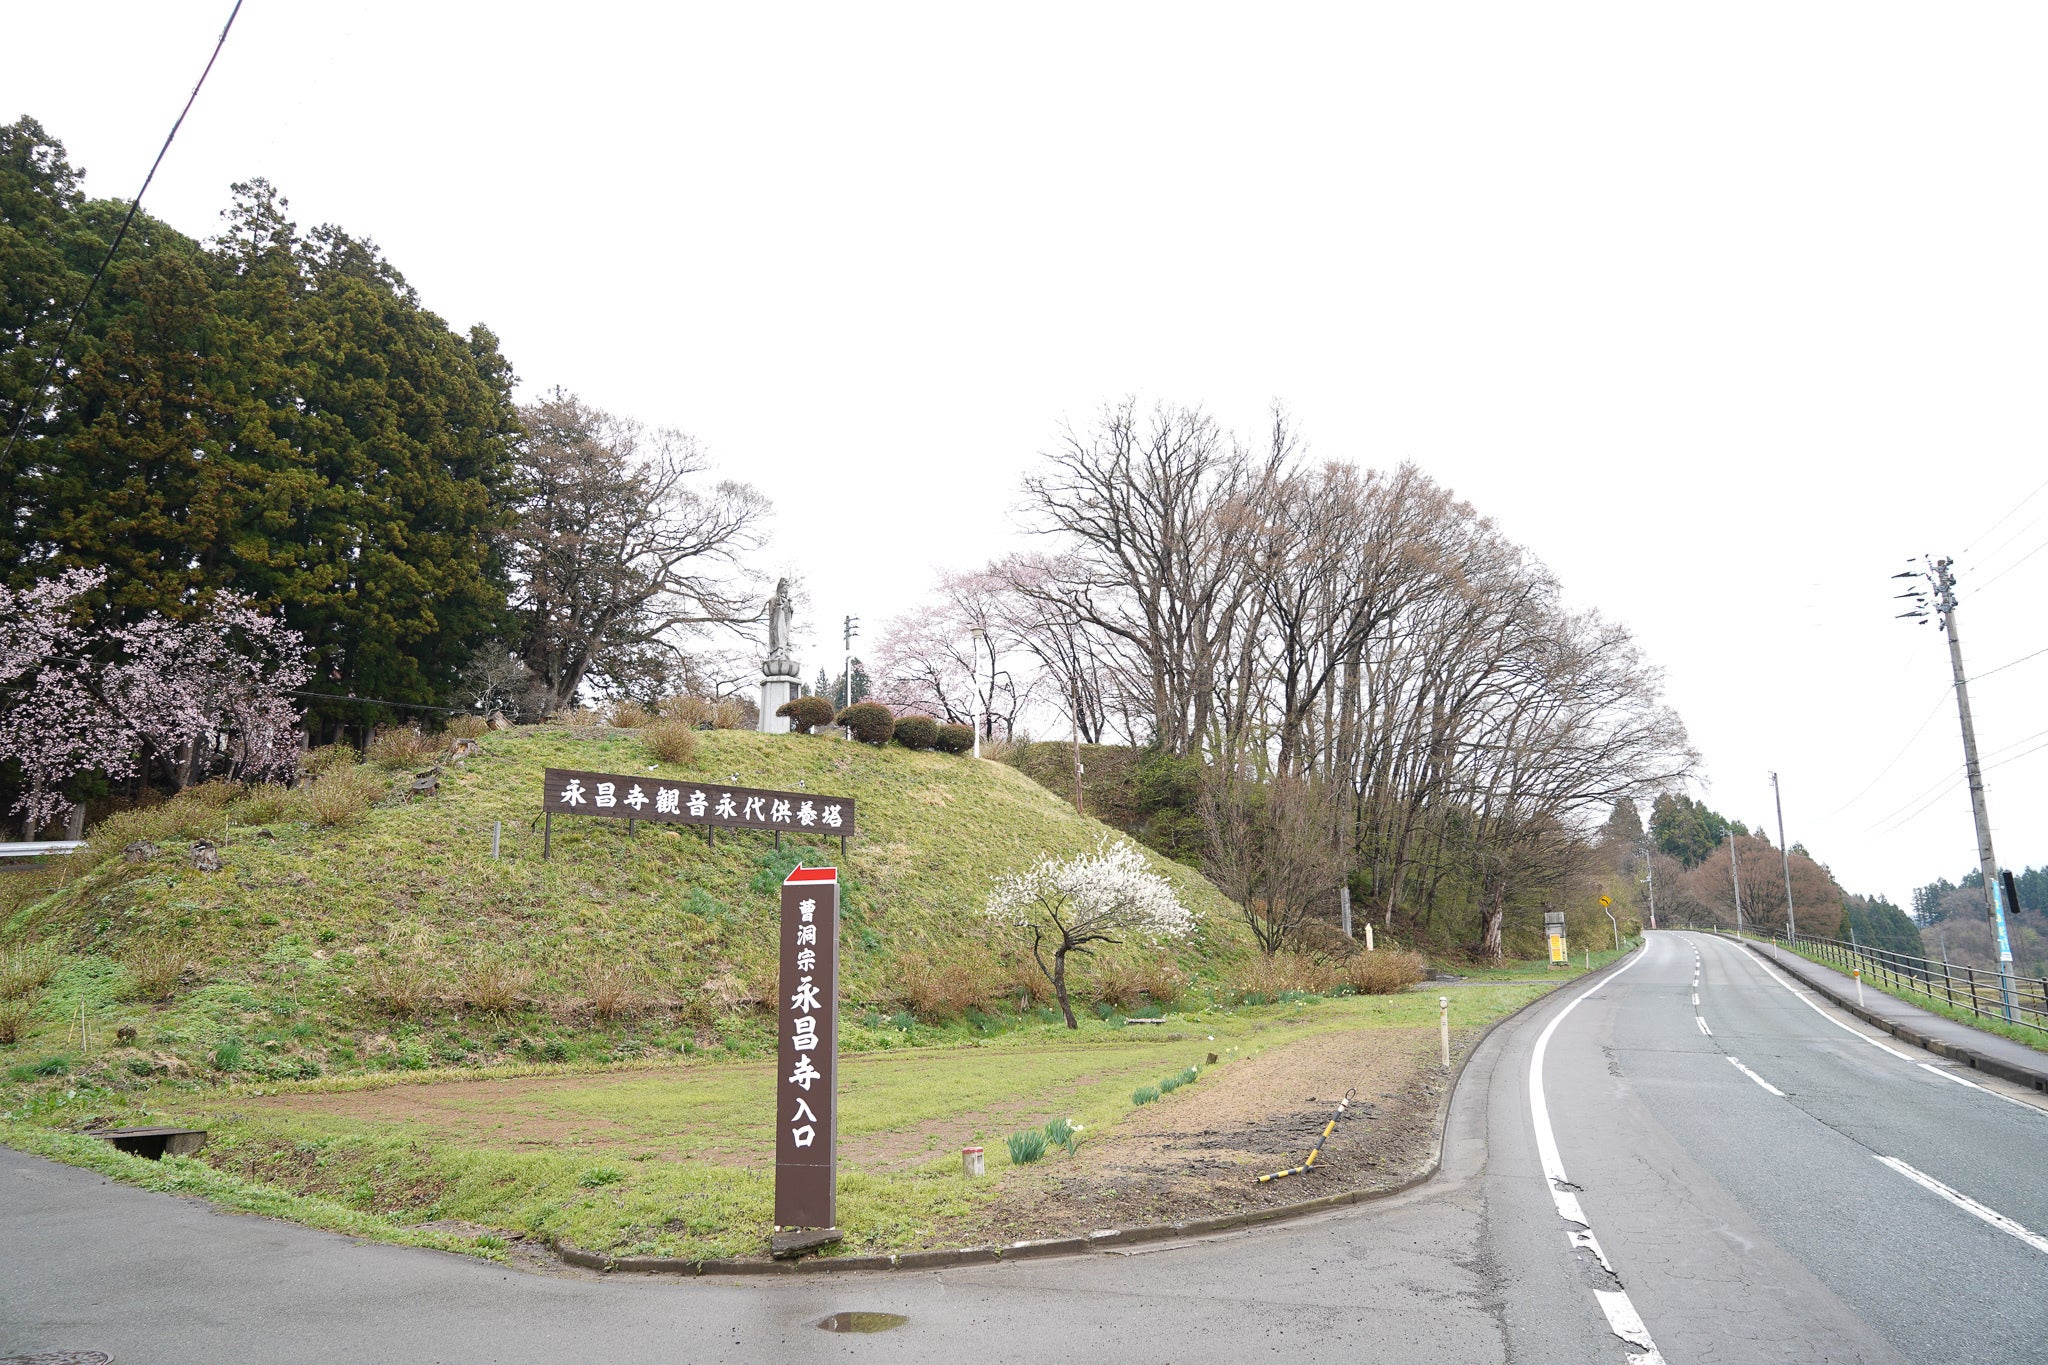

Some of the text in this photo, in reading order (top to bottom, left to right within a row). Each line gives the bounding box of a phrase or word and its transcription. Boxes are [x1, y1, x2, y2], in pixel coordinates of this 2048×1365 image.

[560, 779, 843, 828] 永昌寺観音永代供養塔
